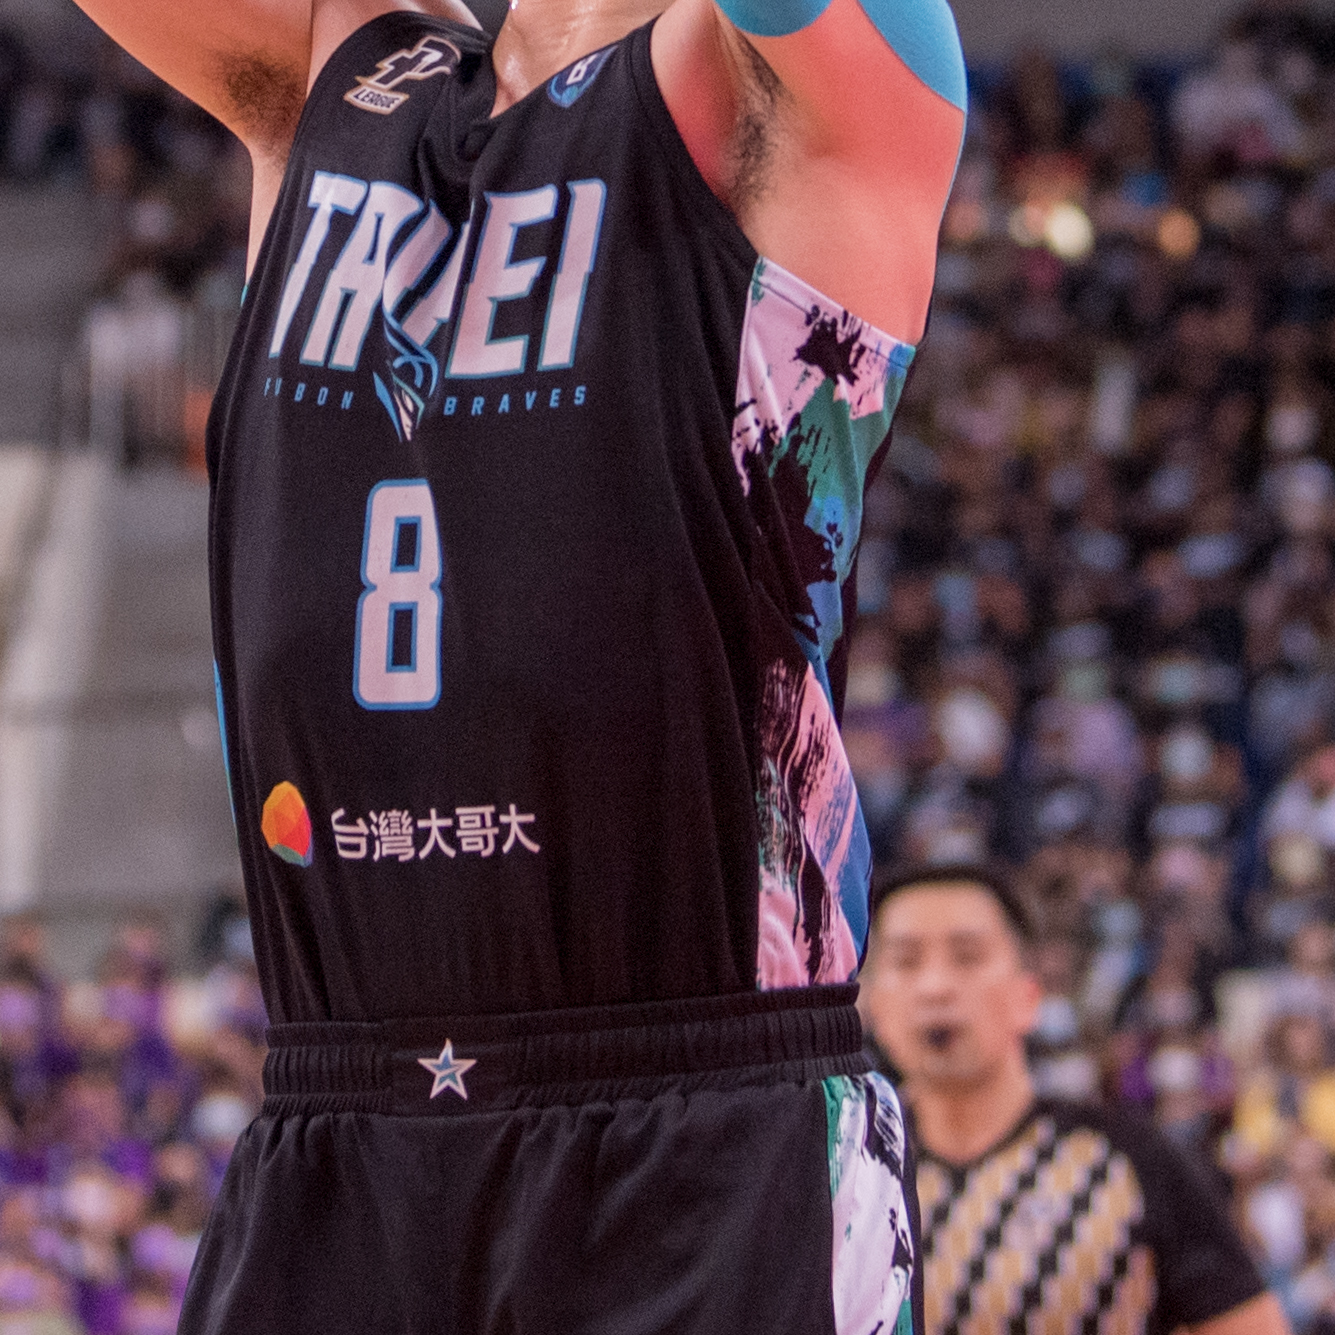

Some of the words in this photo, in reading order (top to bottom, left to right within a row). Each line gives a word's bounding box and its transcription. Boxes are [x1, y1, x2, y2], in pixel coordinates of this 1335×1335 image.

[263, 376, 355, 411] FUBON
[443, 385, 587, 416] BRAVES
[352, 478, 443, 711] 8
[330, 803, 542, 862] 台灣大哥大
